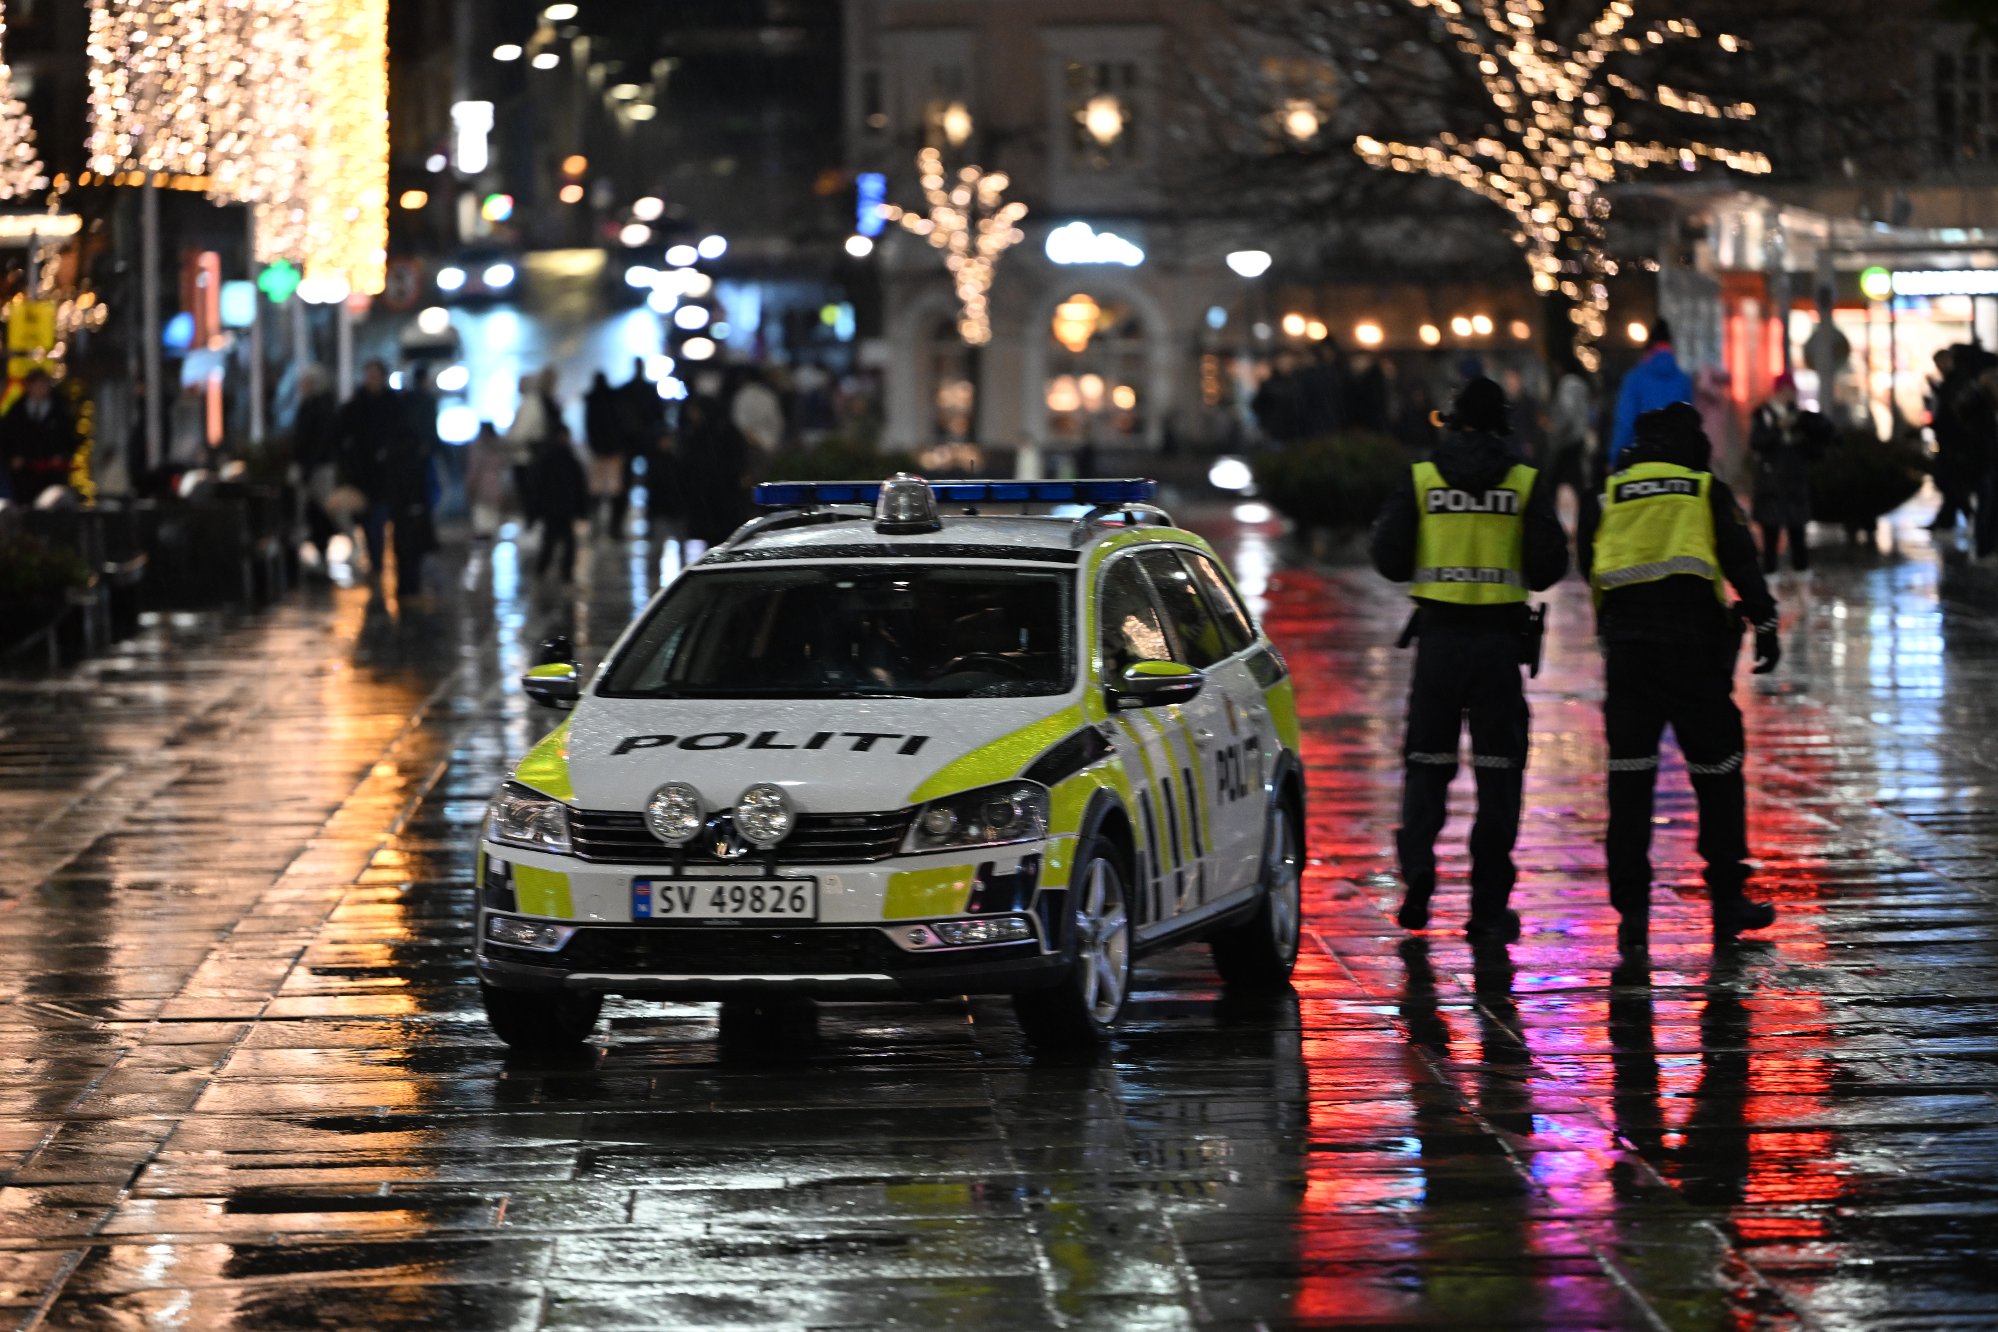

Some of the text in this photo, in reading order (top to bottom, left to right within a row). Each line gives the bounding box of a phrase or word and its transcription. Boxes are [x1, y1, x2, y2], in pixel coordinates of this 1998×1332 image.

[1622, 479, 1693, 498] POLITI
[1441, 567, 1501, 583] POLITI
[610, 731, 930, 755] POLITI
[659, 885, 806, 914] SV 49826
